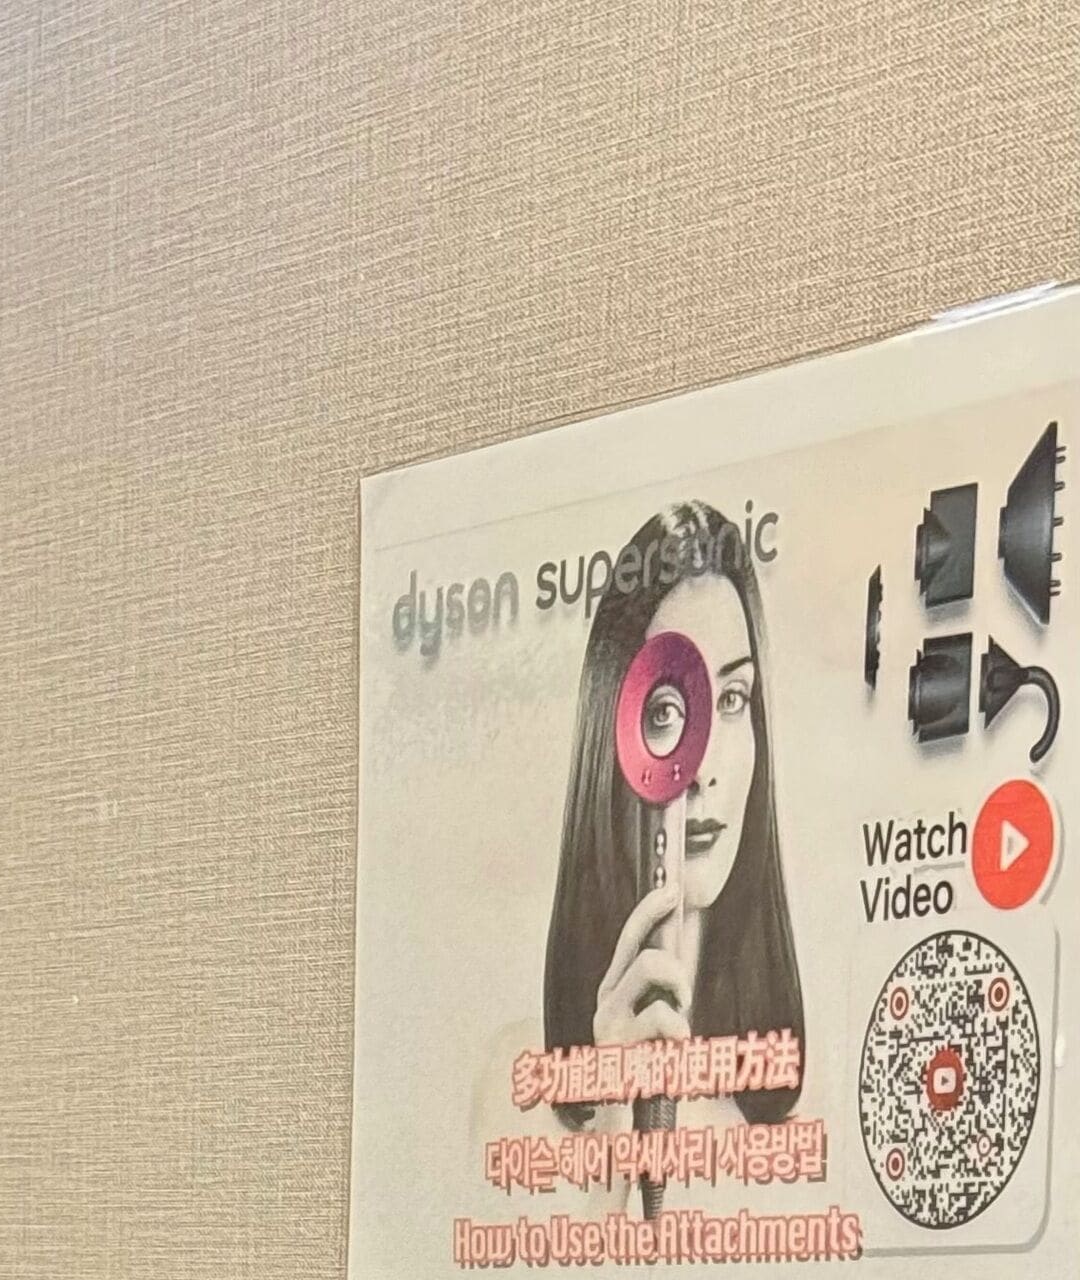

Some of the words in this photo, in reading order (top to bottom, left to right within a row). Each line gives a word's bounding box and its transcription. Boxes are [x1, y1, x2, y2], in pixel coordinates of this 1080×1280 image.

[392, 569, 520, 658] dyson
[534, 499, 779, 620] supersonic
[862, 811, 968, 867] Watch
[860, 874, 954, 923] Video
[511, 1028, 801, 1109] 多功能風嘴的使用方法
[485, 1136, 557, 1190] 다이슨
[613, 1125, 715, 1187] 악세사리
[718, 1118, 825, 1182] 사용방법
[453, 1217, 515, 1266] How
[517, 1215, 551, 1260] to
[550, 1214, 603, 1262] Use
[605, 1211, 657, 1260] the
[658, 1205, 862, 1259] Attachments
